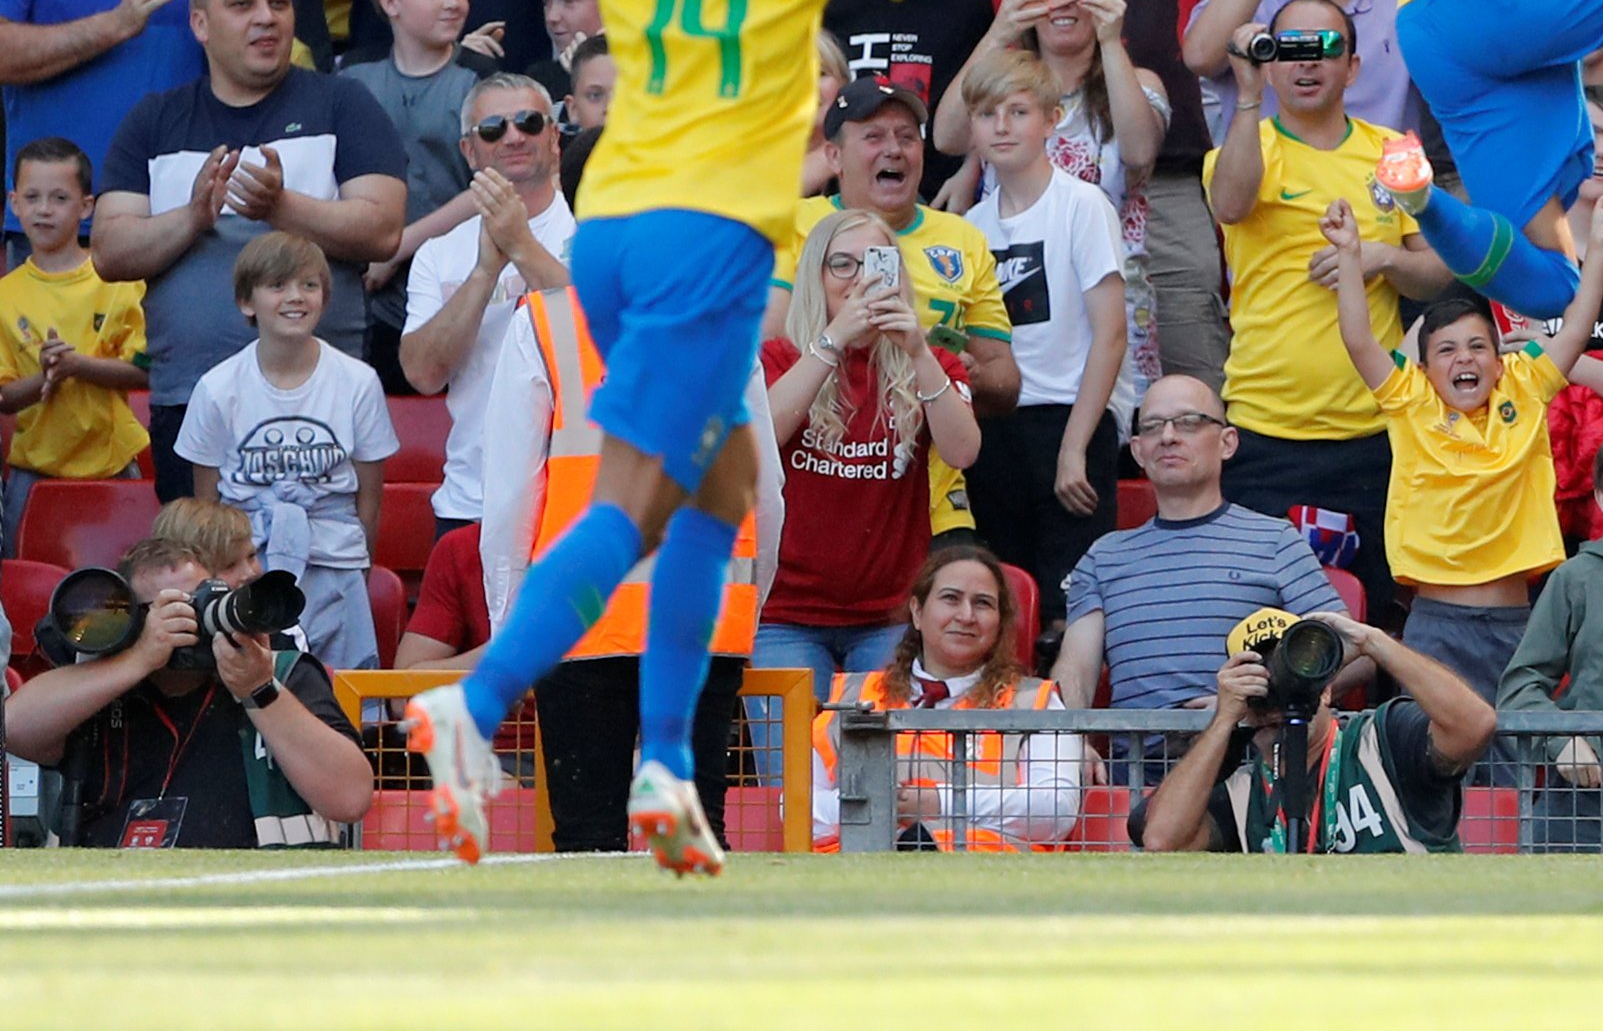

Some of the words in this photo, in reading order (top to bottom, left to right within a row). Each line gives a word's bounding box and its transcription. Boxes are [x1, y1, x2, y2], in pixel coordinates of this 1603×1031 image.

[892, 34, 918, 43] NEVER
[891, 44, 913, 52] STOP
[890, 53, 933, 65] EXPLORING
[791, 449, 888, 480] Chartered
[1246, 615, 1288, 635] Let's
[1332, 783, 1384, 853] 94
